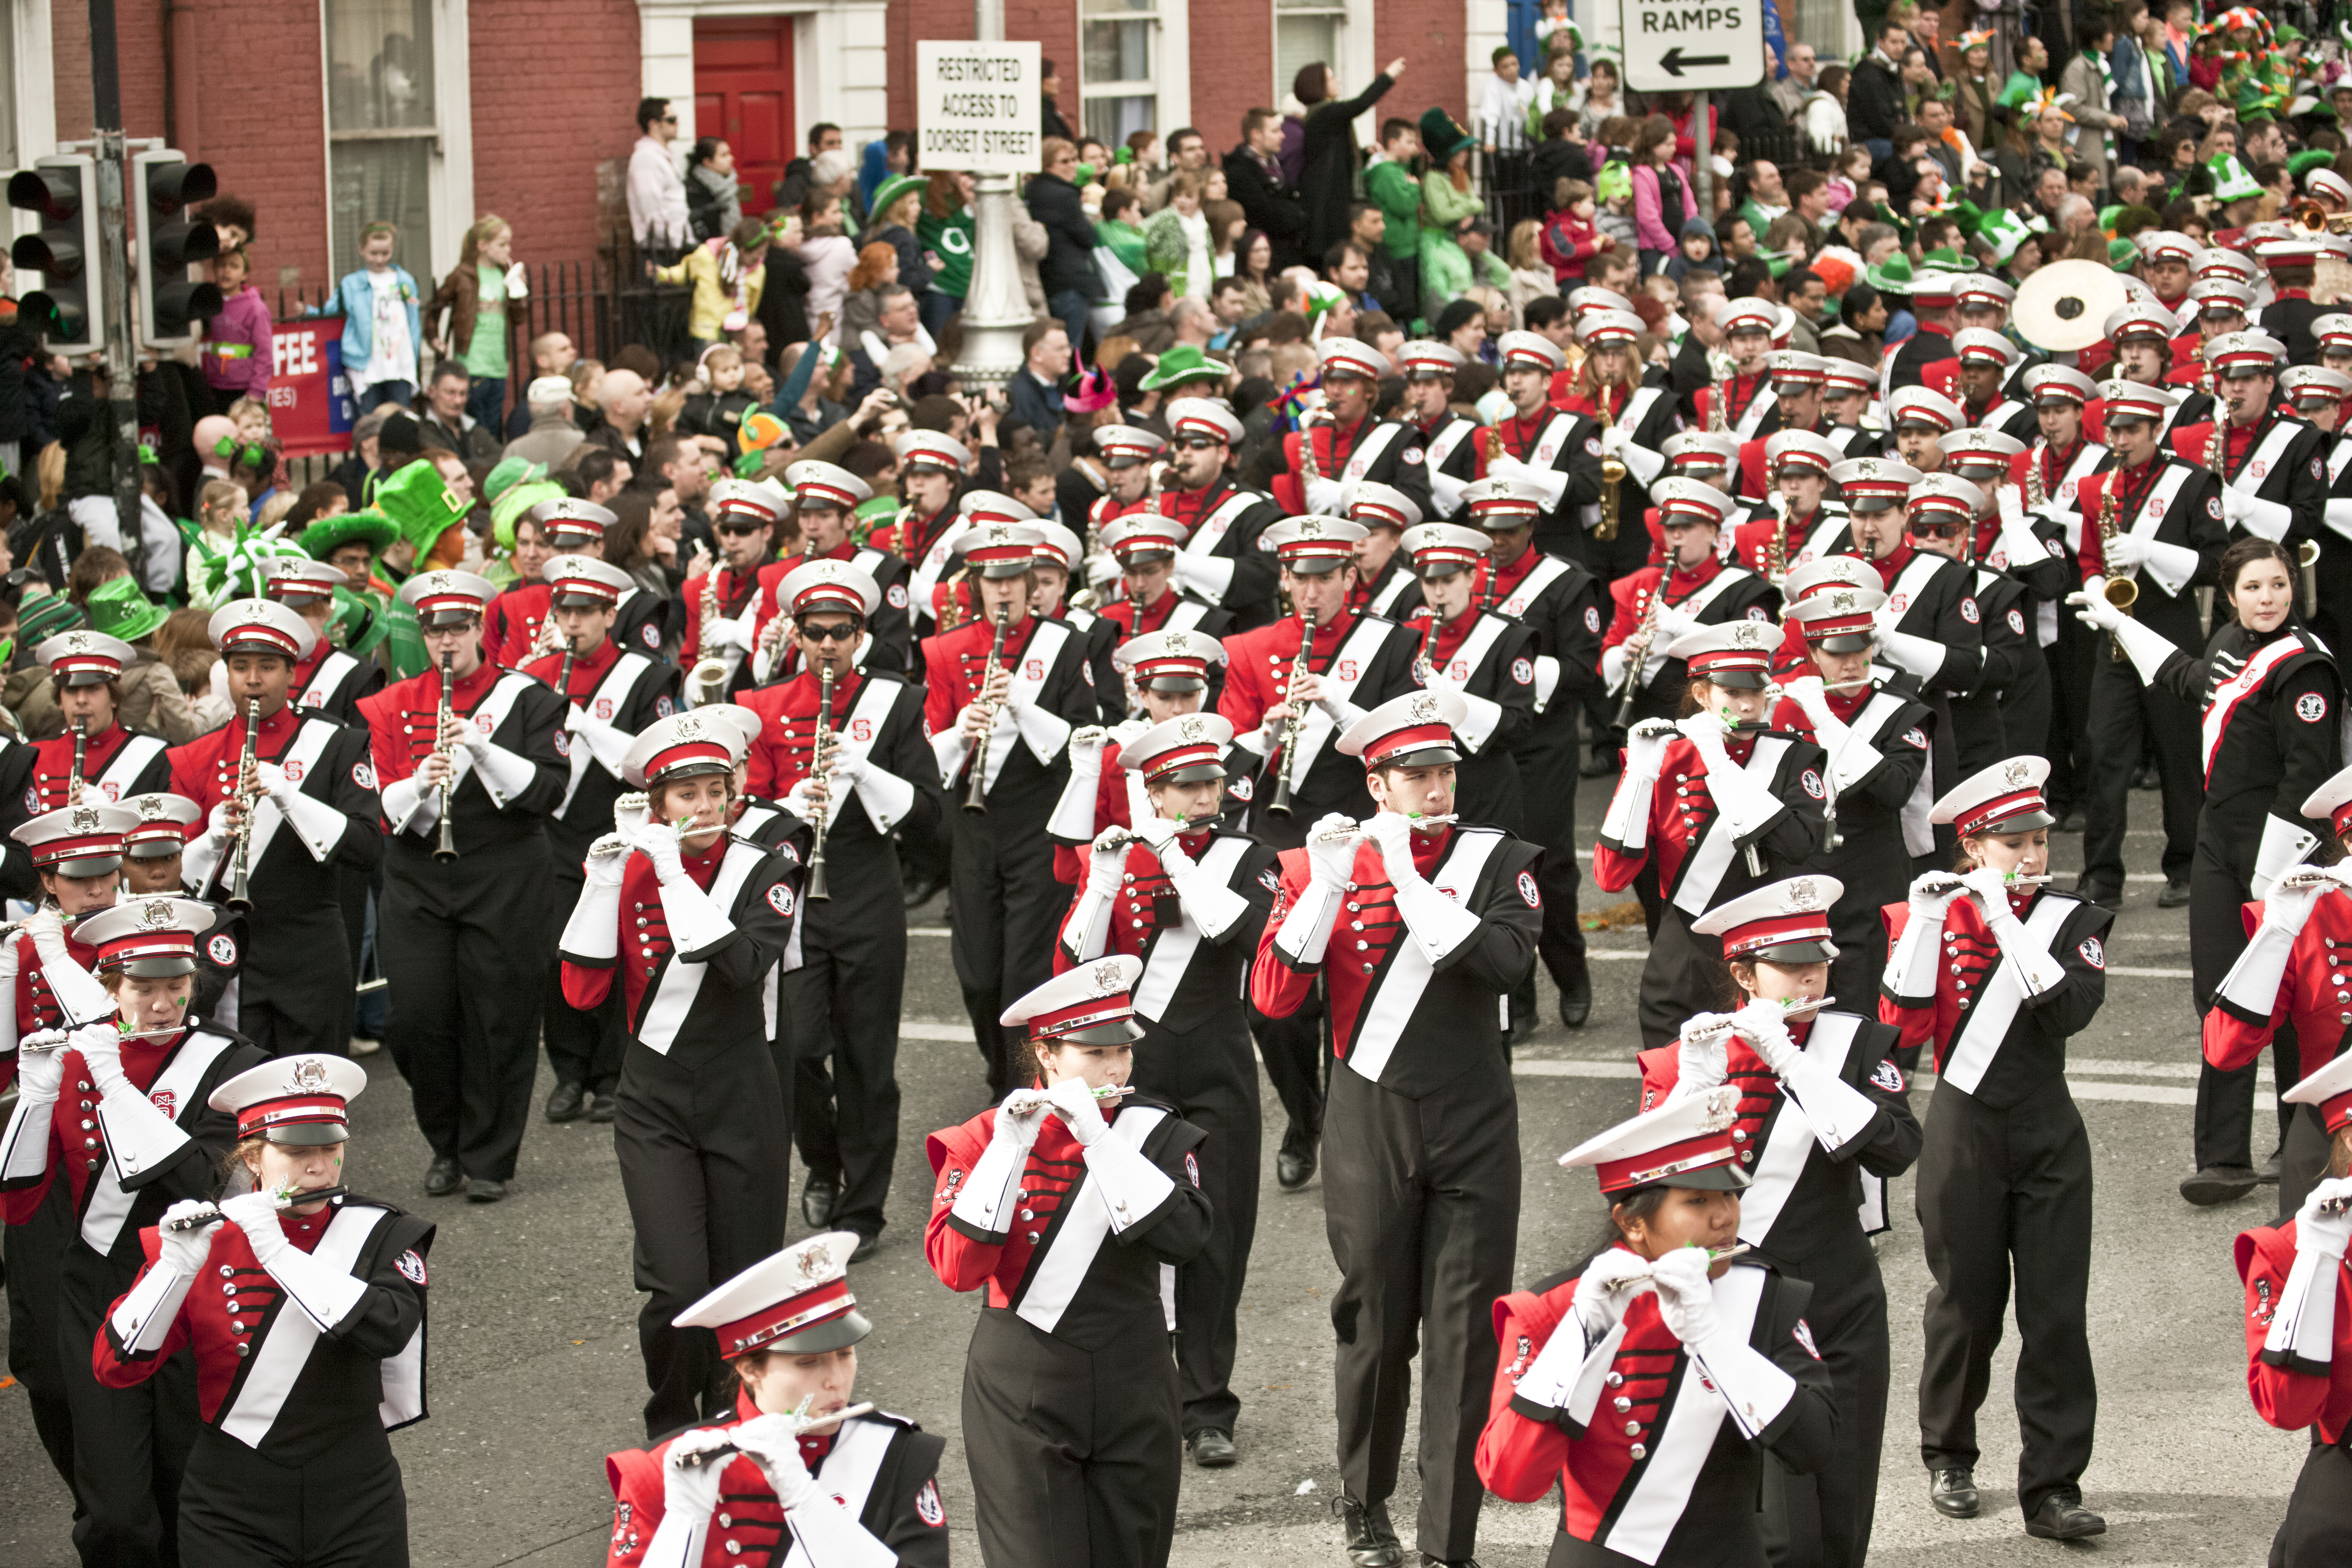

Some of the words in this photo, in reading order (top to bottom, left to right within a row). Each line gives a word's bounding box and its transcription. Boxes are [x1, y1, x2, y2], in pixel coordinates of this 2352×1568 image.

[1642, 7, 1741, 33] RAMPS
[938, 57, 1021, 82] RESTRICTED
[941, 93, 995, 118] ACCESS
[1000, 95, 1018, 118] TO
[926, 129, 979, 153] DORSET
[983, 131, 1034, 155] STREET
